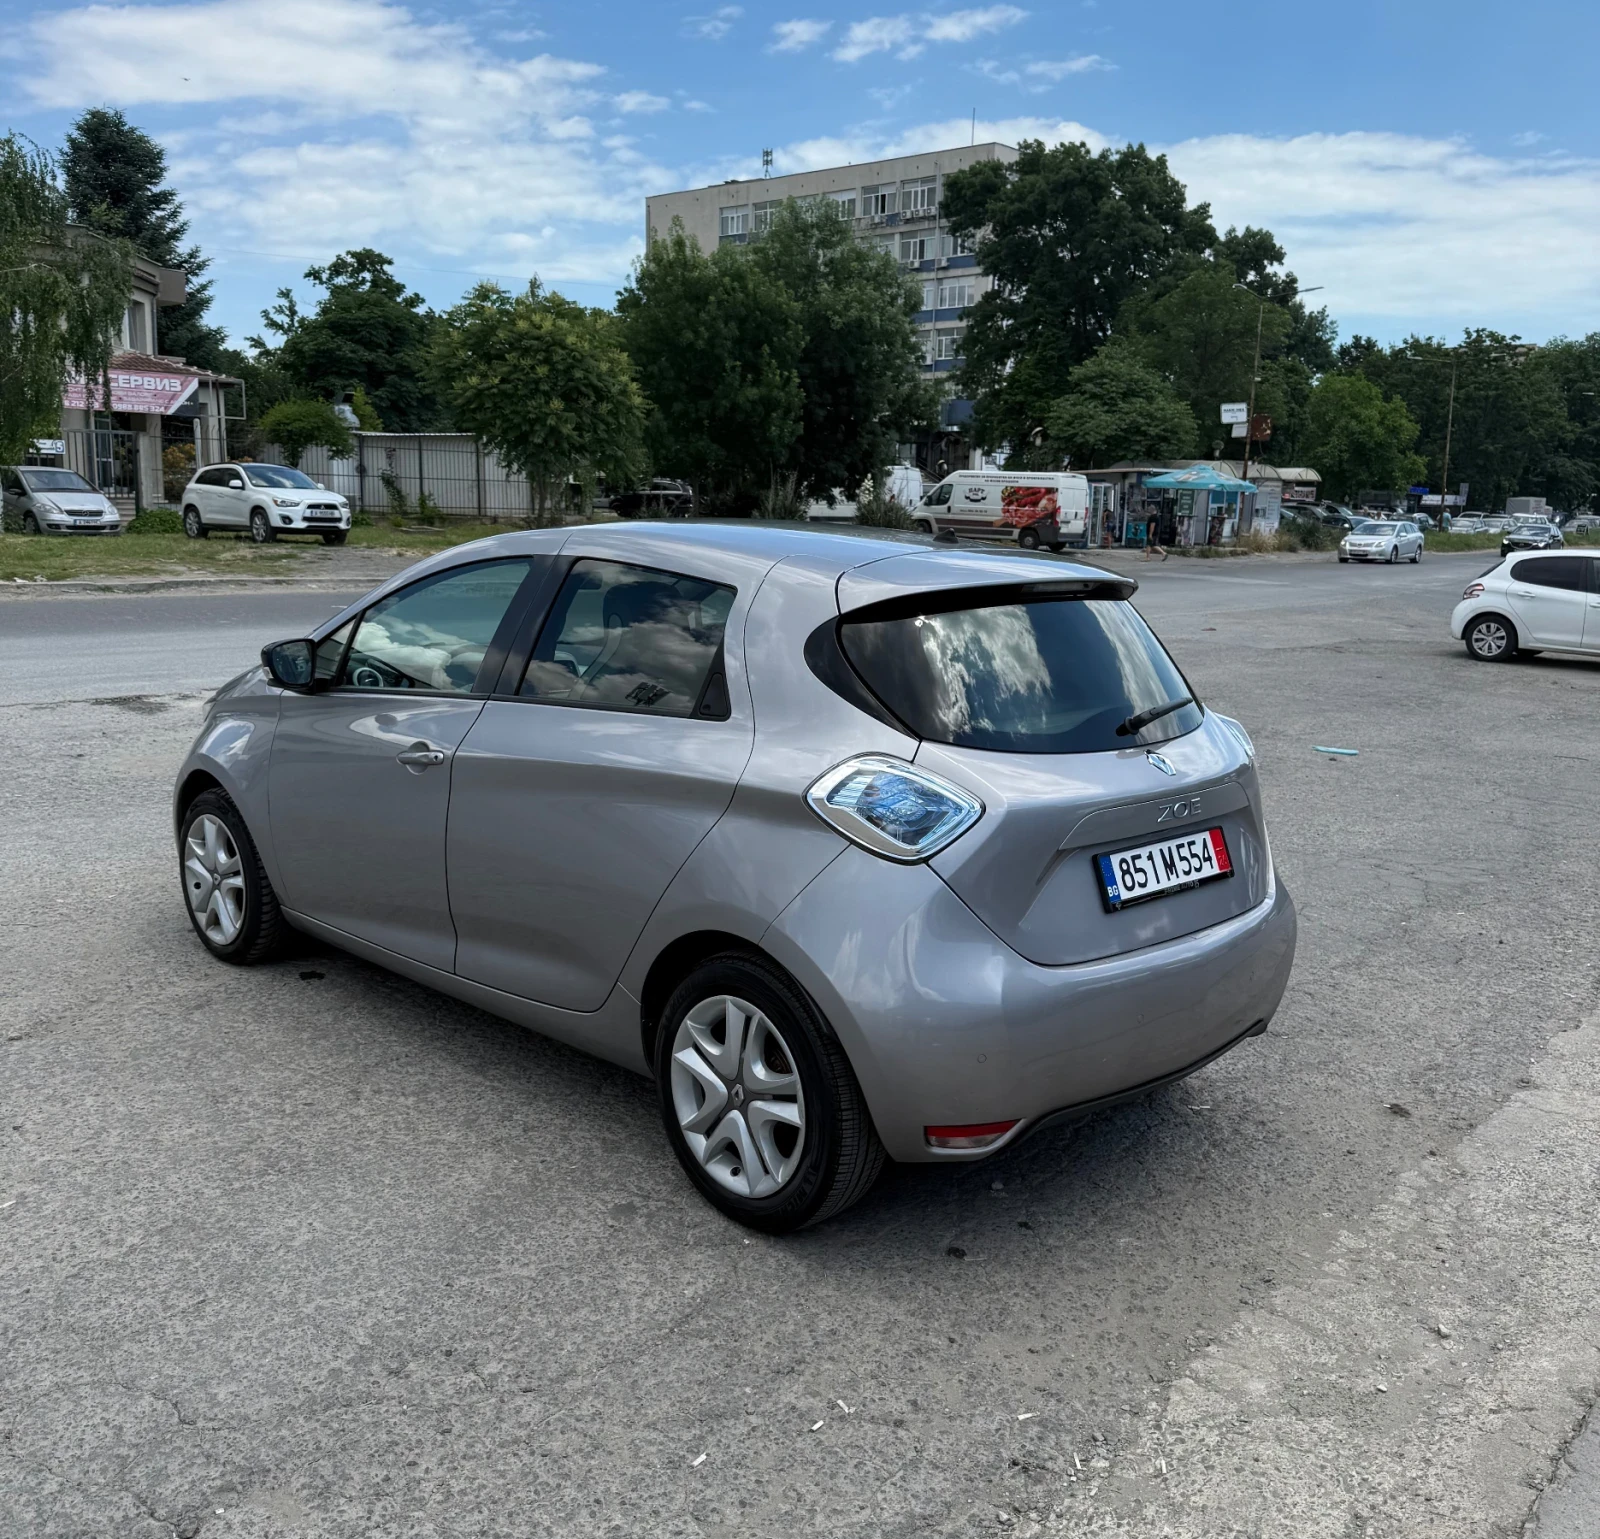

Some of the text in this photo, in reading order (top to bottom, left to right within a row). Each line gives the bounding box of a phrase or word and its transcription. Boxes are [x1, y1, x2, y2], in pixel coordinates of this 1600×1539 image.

[108, 374, 182, 392] СЕРВИЗ
[1157, 797, 1202, 822] ZOE
[1107, 885, 1119, 897] BG
